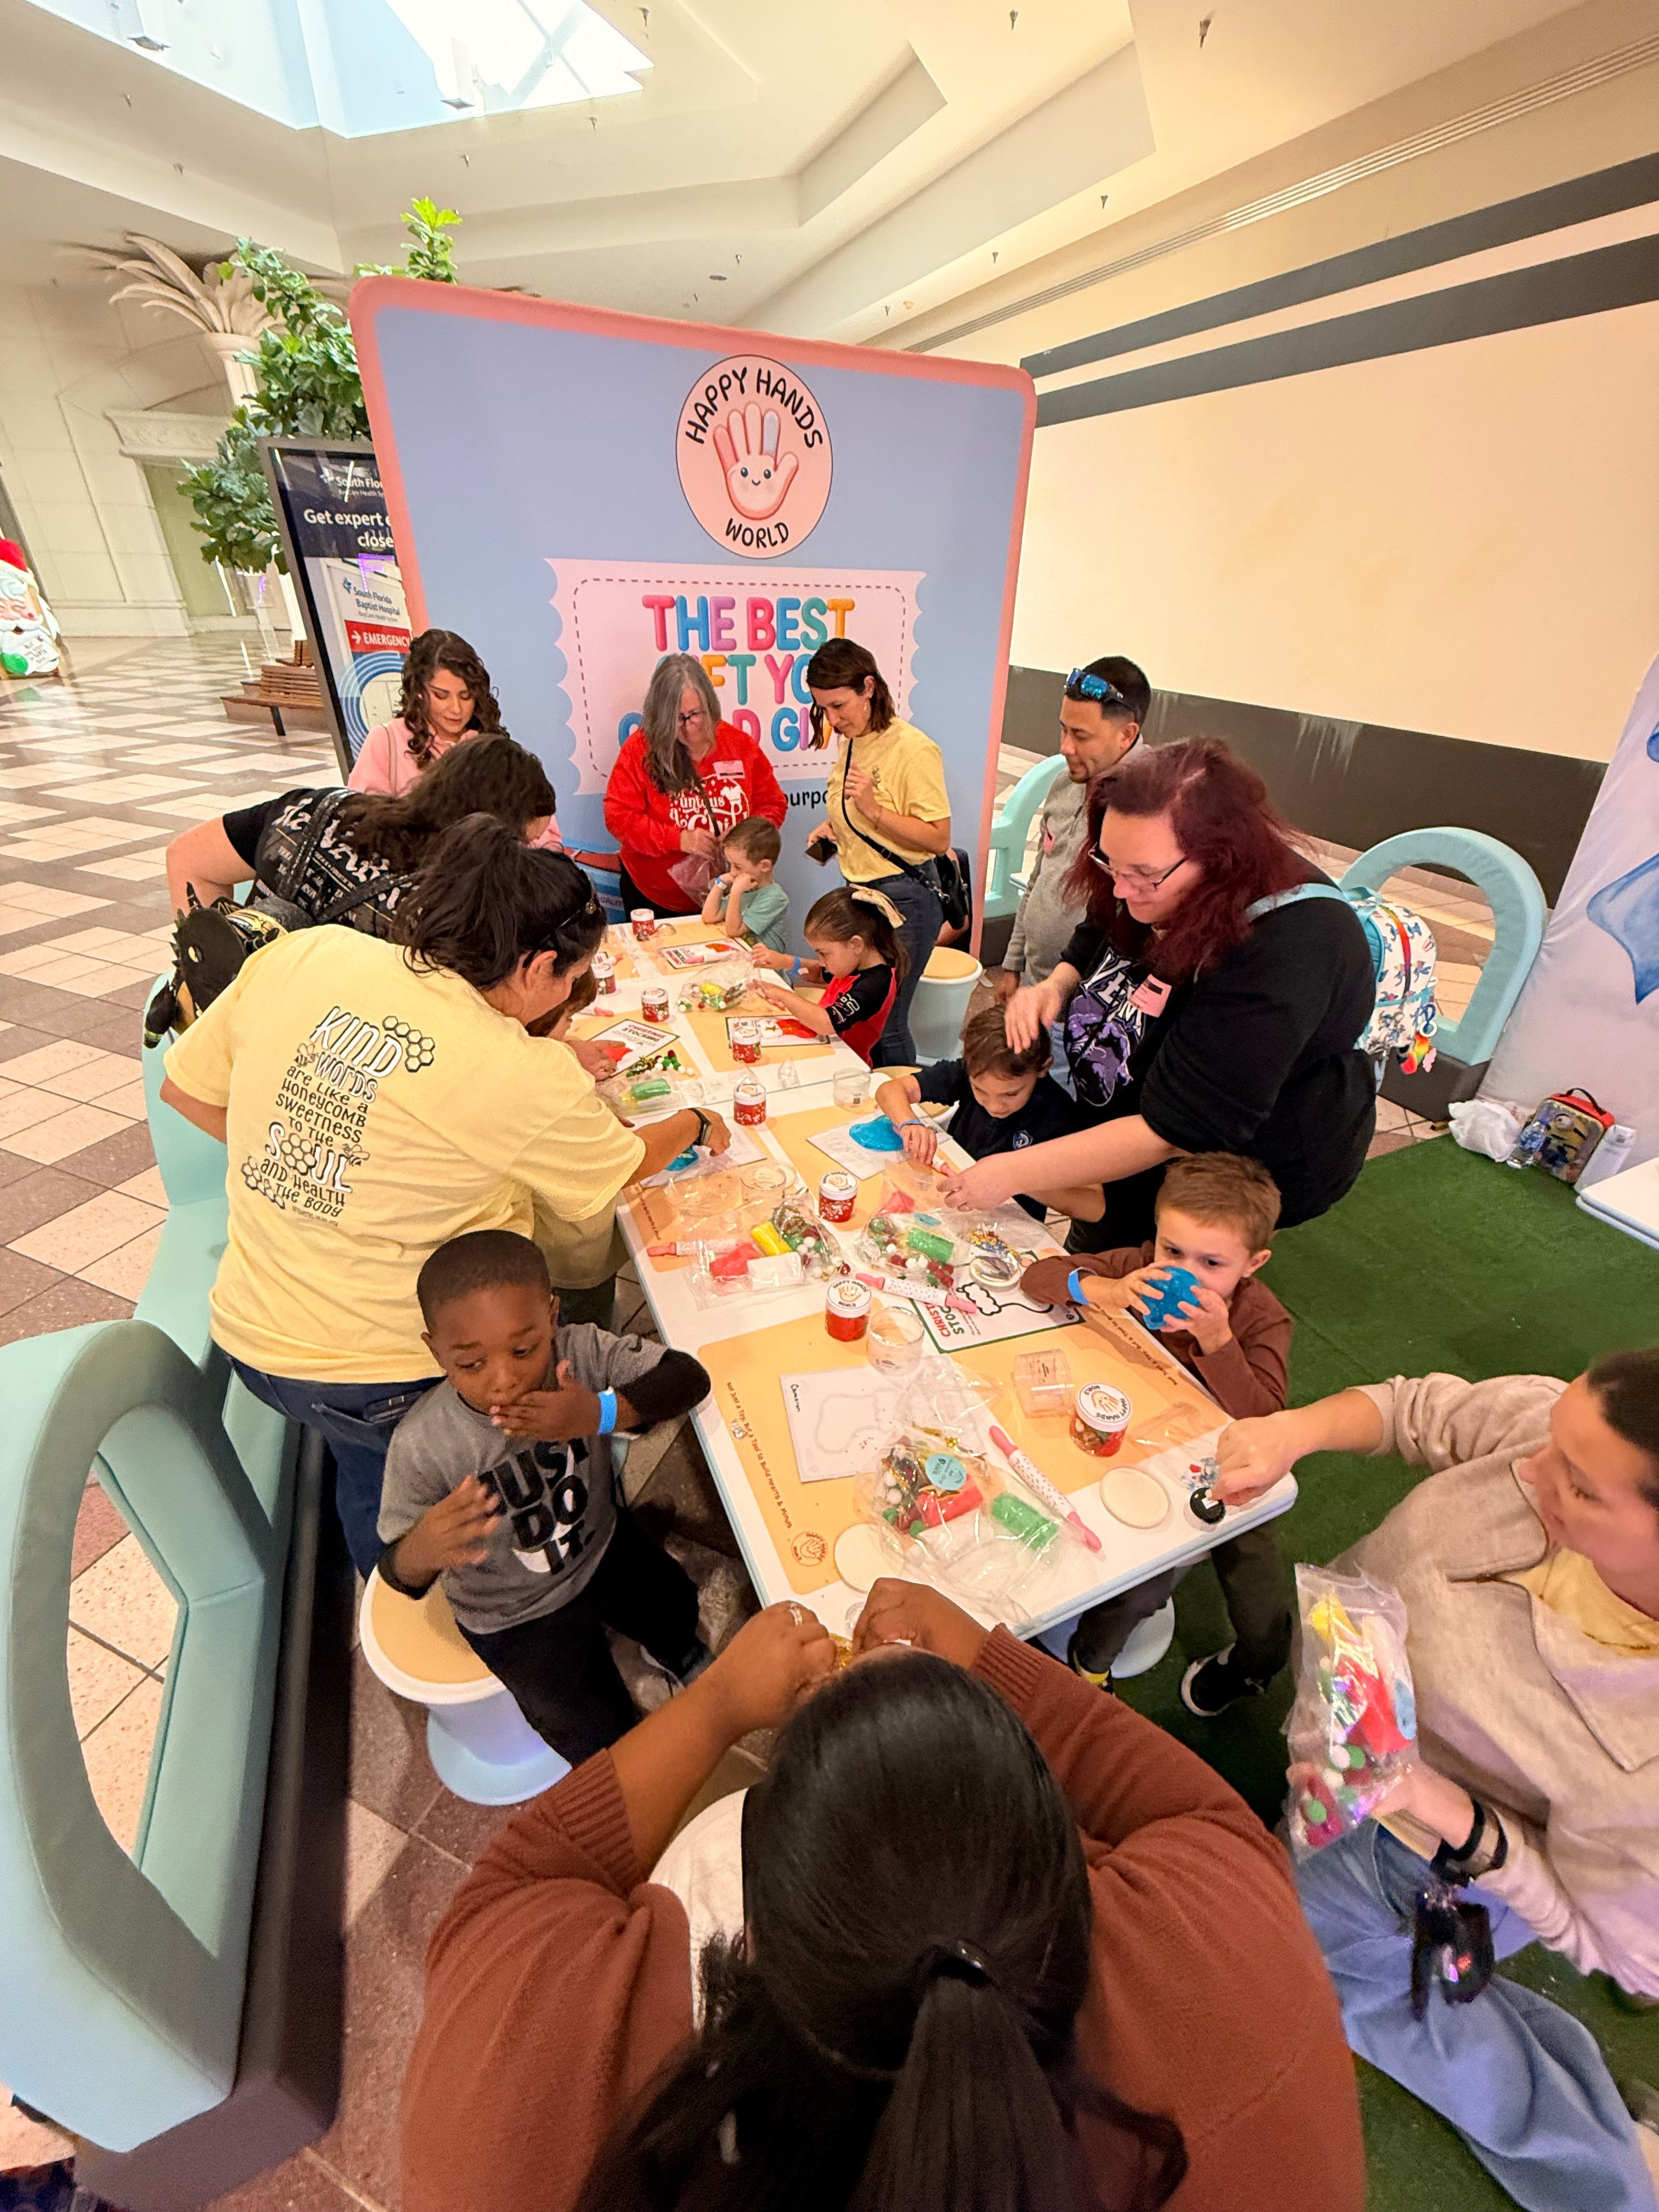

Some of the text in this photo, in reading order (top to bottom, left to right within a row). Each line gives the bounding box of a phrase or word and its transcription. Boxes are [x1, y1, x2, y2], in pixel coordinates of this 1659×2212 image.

[685, 366, 823, 448] HAPPY HANDS
[303, 508, 334, 524] Get
[335, 511, 384, 529] expert
[725, 517, 789, 549] WORLD
[353, 586, 392, 604] South Florida
[356, 599, 400, 616] Baptist Hospital
[642, 594, 856, 652] THE BEST
[363, 632, 410, 647] EMERGENCY
[657, 653, 813, 706] FT YO
[287, 1065, 312, 1086] are
[358, 1102, 368, 1114] a
[833, 1280, 869, 1293] HAPPY HANDS
[923, 1302, 951, 1337] CHRIST
[936, 1305, 965, 1335] STOC
[791, 1384, 800, 1412] Cameron
[1084, 1385, 1101, 1396] WORLD
[1096, 1398, 1128, 1421] HAPPY HANDS
[730, 1392, 740, 1404] Just
[751, 1438, 761, 1452] Tool
[760, 1461, 772, 1477] Build
[768, 1477, 780, 1500] Hearts
[780, 1508, 793, 1528] Minds
[511, 1475, 588, 1548] DO
